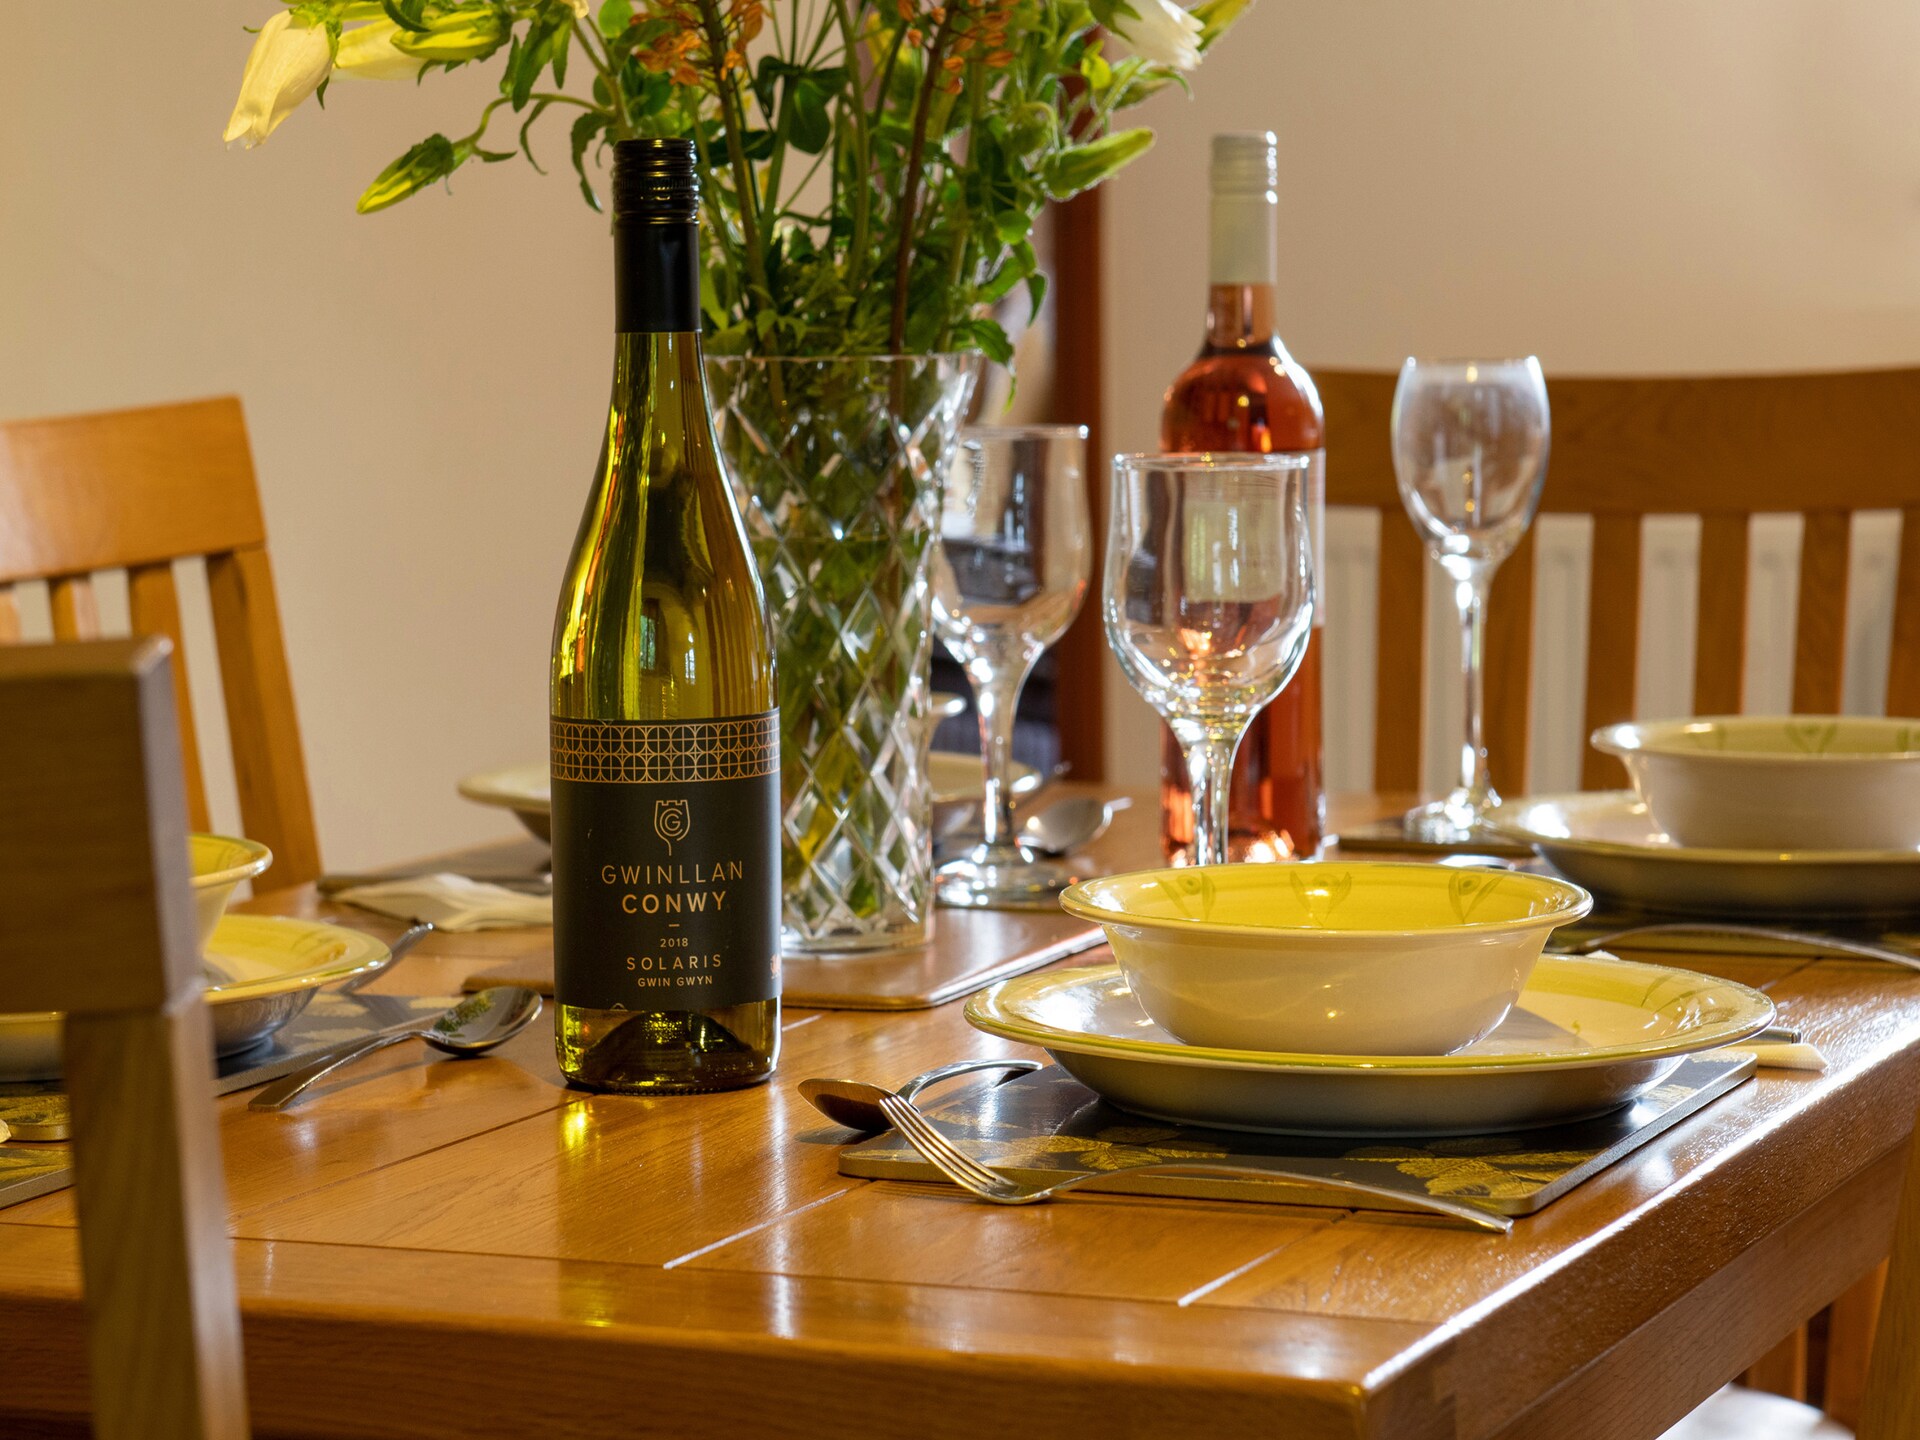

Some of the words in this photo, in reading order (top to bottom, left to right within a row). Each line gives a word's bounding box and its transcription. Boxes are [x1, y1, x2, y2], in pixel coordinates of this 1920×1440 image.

[601, 860, 743, 885] GWINLLAN
[622, 891, 726, 914] CONWY
[660, 937, 689, 948] 2018
[626, 954, 721, 971] SOLARIS
[637, 977, 671, 988] GWIN
[676, 975, 713, 986] GWYN
